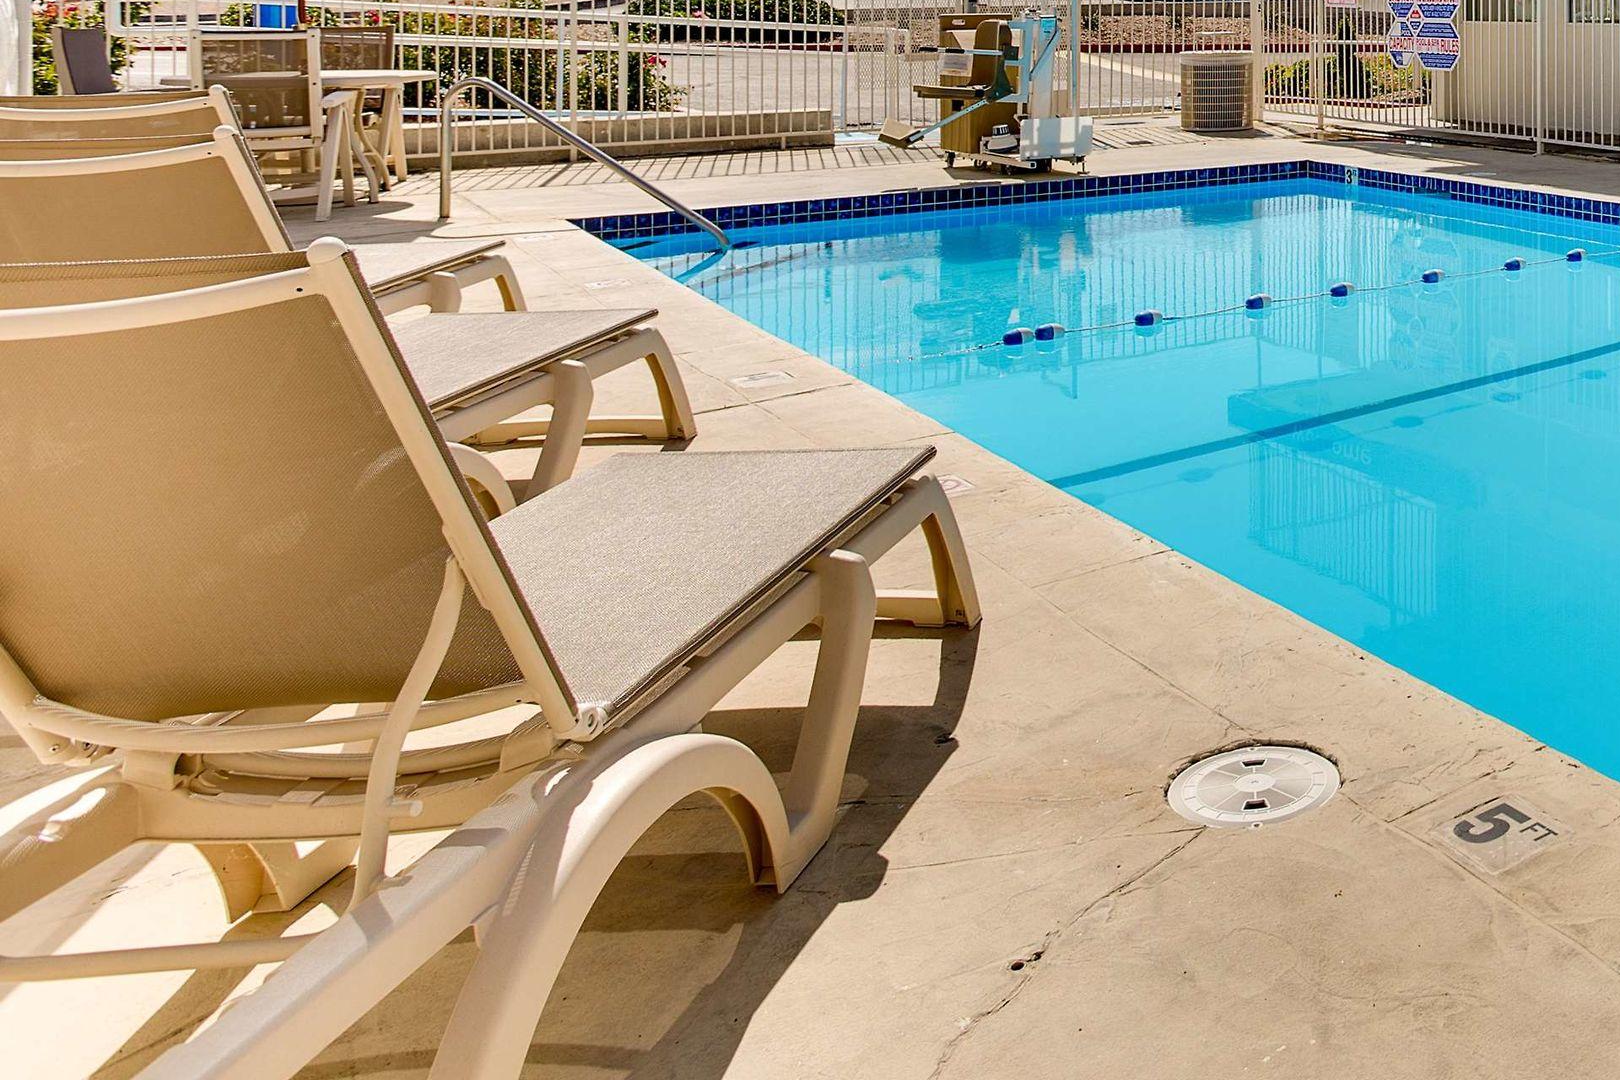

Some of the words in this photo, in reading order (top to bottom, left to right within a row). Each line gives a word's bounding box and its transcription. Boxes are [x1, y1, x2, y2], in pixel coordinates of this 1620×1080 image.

[1389, 37, 1414, 50] CAPACITY
[1440, 38, 1459, 53] RULES
[1346, 169, 1352, 183] 3
[1453, 802, 1532, 844] 5
[1519, 822, 1559, 841] FT
